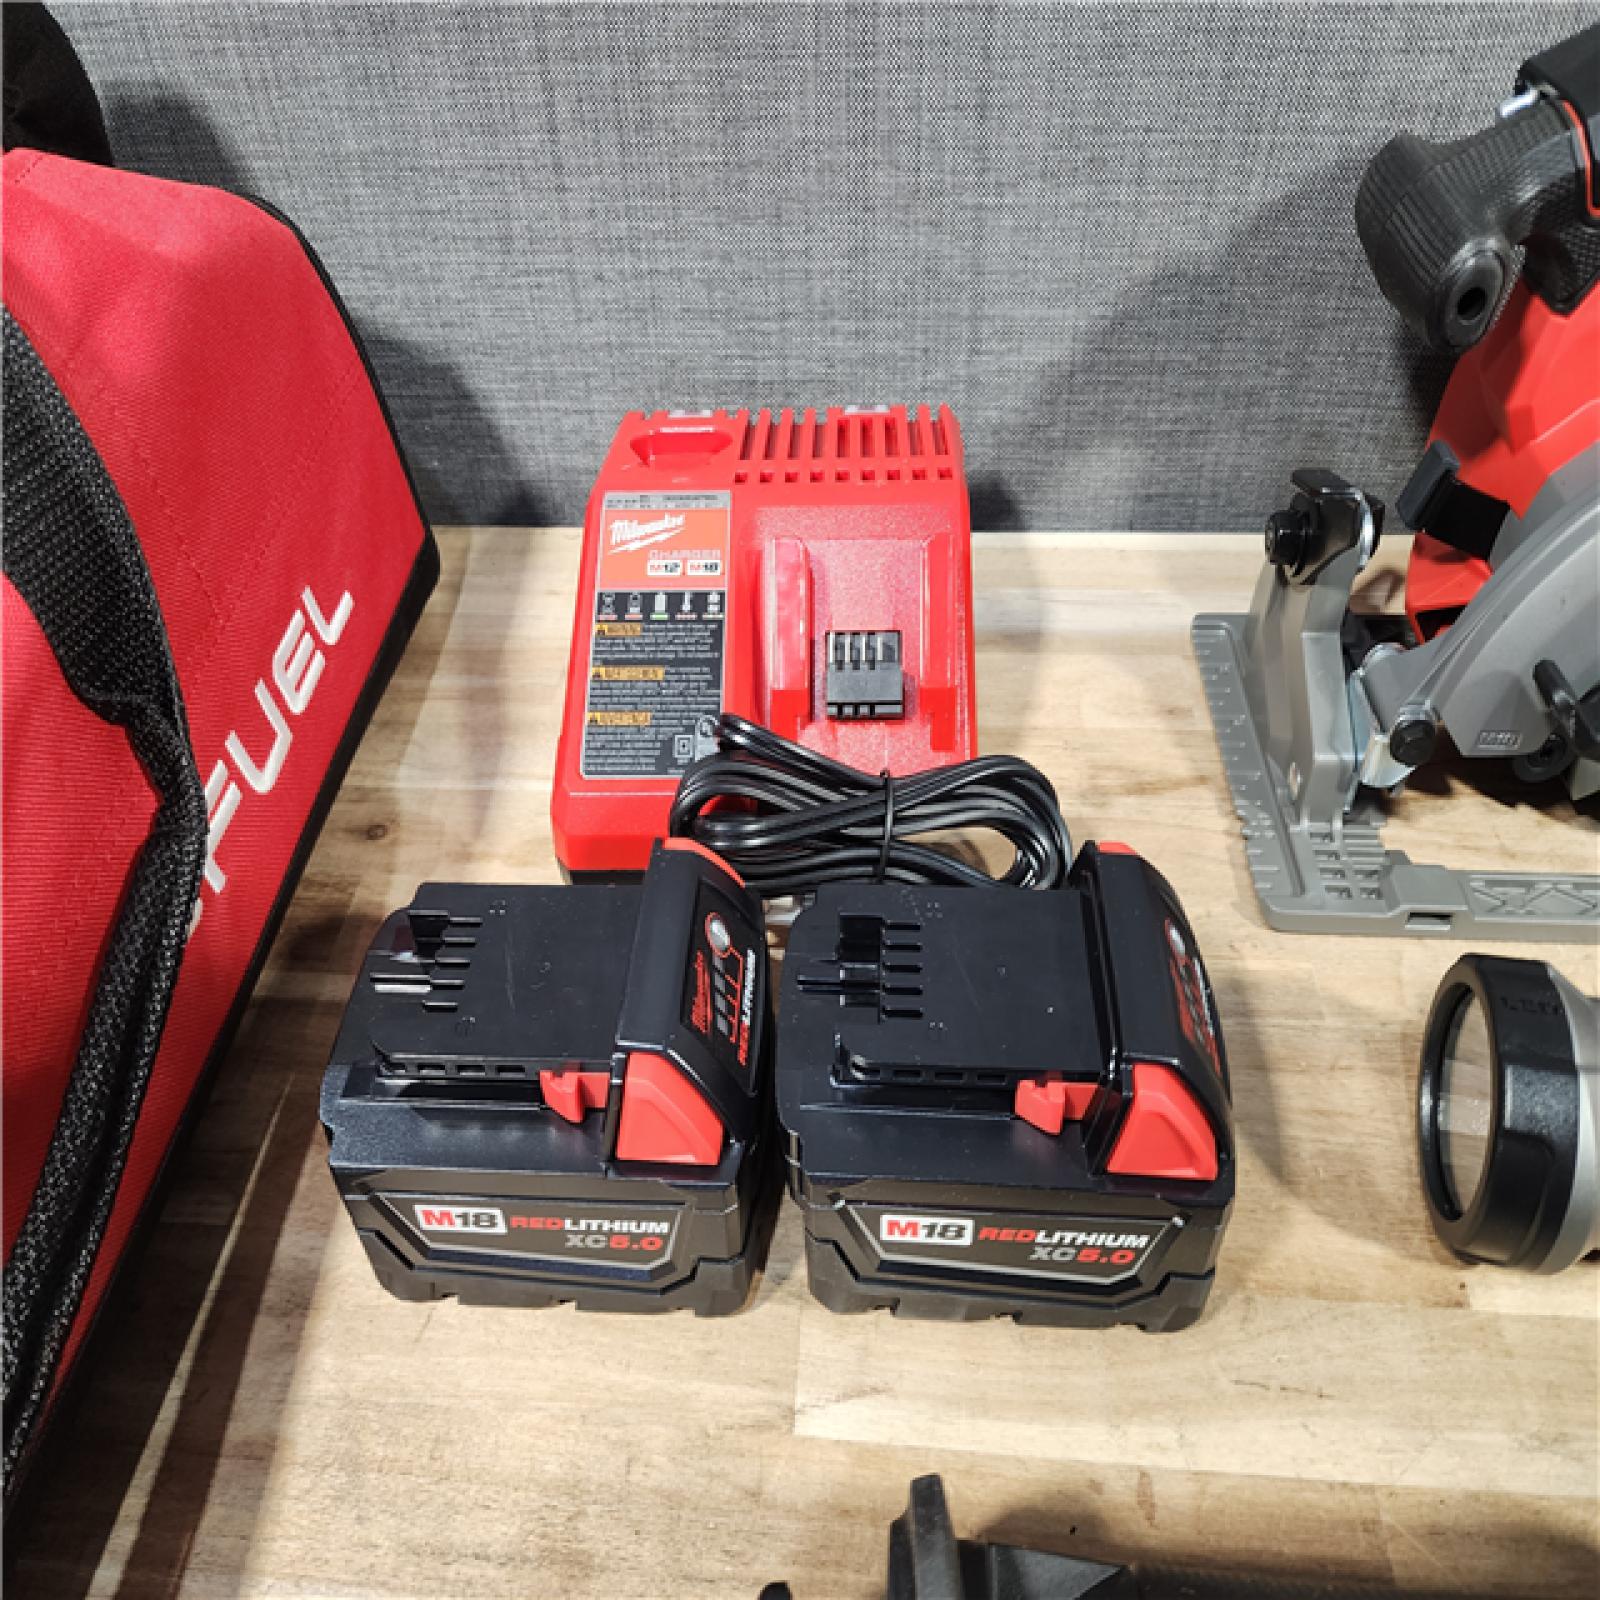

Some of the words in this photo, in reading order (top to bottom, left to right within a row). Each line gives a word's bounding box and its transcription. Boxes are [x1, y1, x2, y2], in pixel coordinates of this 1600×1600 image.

[203, 585, 354, 894] FUEL
[420, 1209, 500, 1229] M18
[509, 1216, 669, 1234] REDLITHIUM
[887, 1219, 968, 1240] M18
[978, 1226, 1151, 1249] REDLITHIUM
